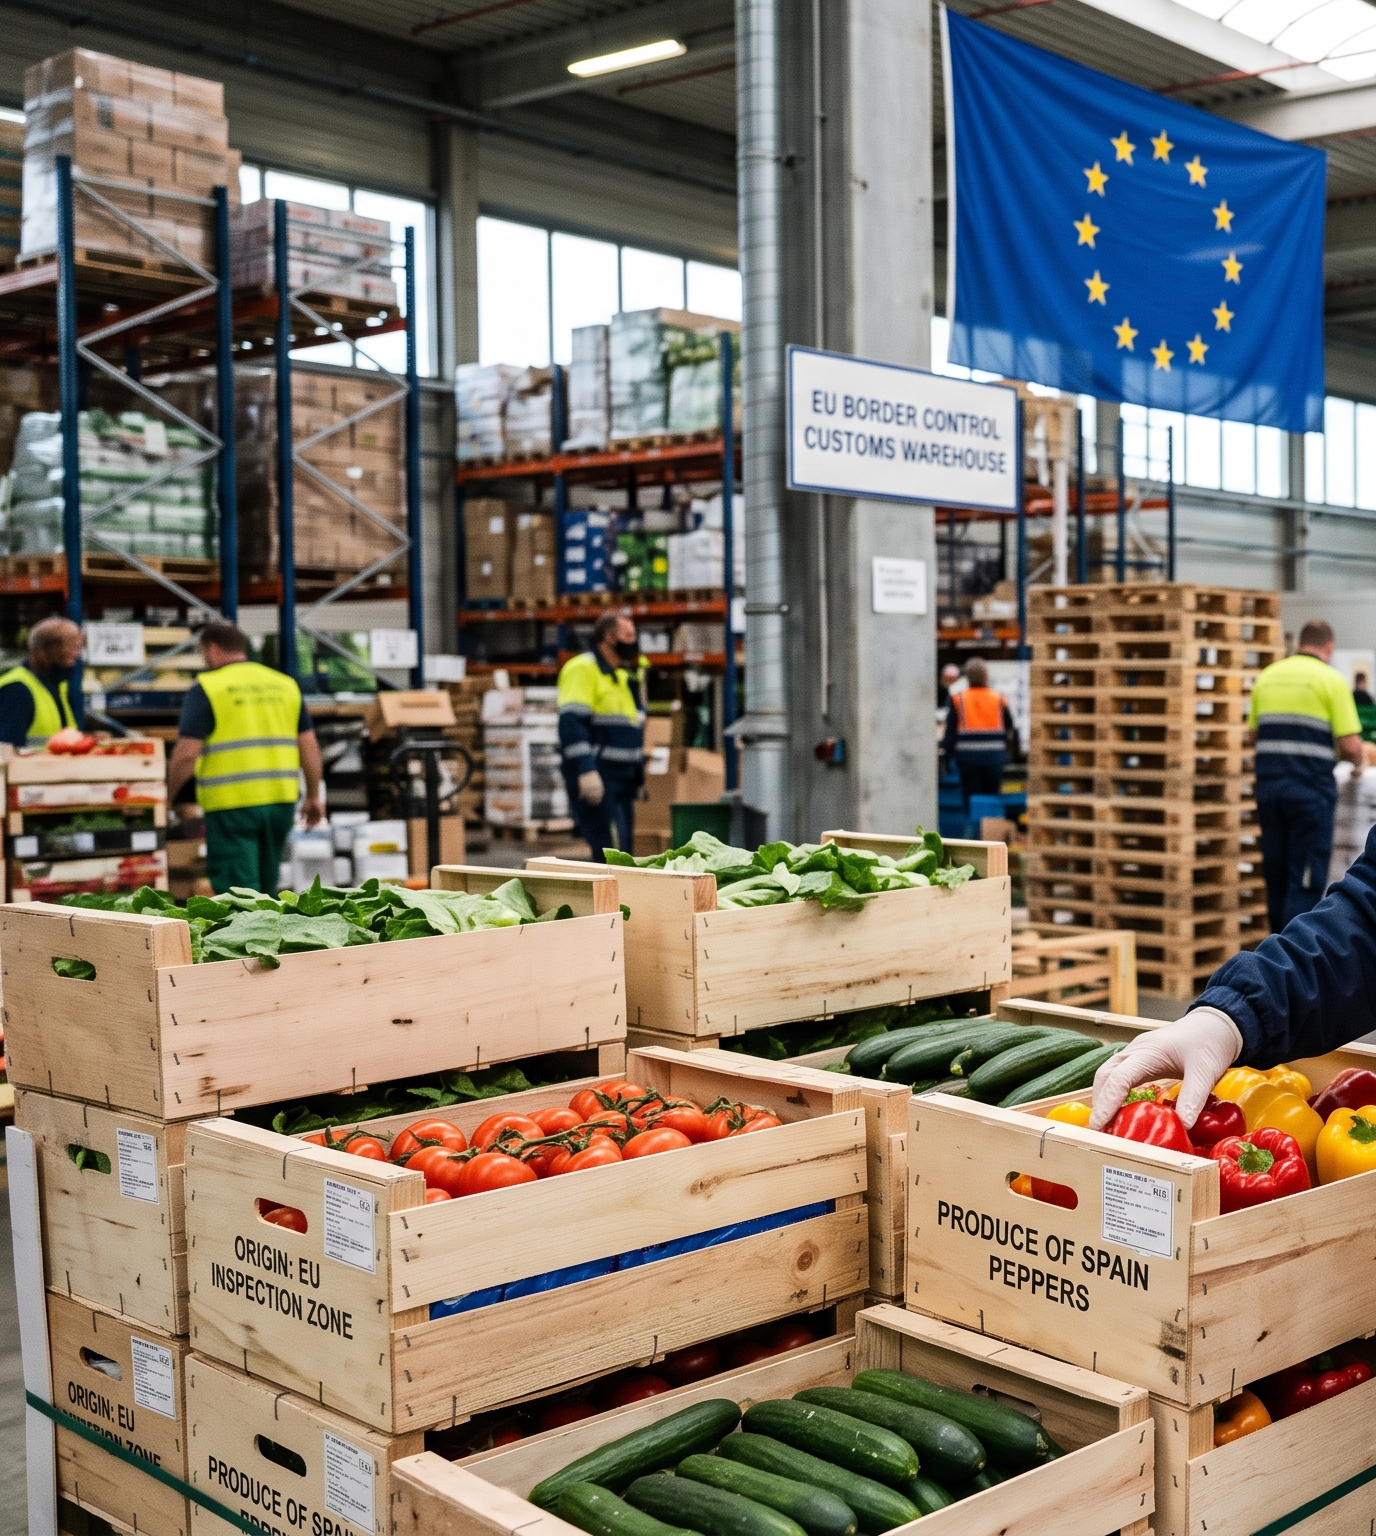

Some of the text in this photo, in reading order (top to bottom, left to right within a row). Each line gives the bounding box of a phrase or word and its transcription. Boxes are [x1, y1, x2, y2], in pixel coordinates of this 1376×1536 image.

[812, 390, 1001, 440] EU BORDER CONTROL
[804, 426, 1008, 474] CUSTOMS WAREHOUSE
[234, 1235, 320, 1289] ORIGIN: EU
[938, 1200, 1149, 1291] PRODUCE OF SPAIN
[211, 1262, 353, 1340] INSPECTION ZONE
[989, 1254, 1090, 1312] PEPPERS
[68, 1381, 114, 1423] ORIGIN:
[117, 1403, 135, 1432] EU
[208, 1455, 282, 1518] PRODUCE
[286, 1498, 307, 1529] OF
